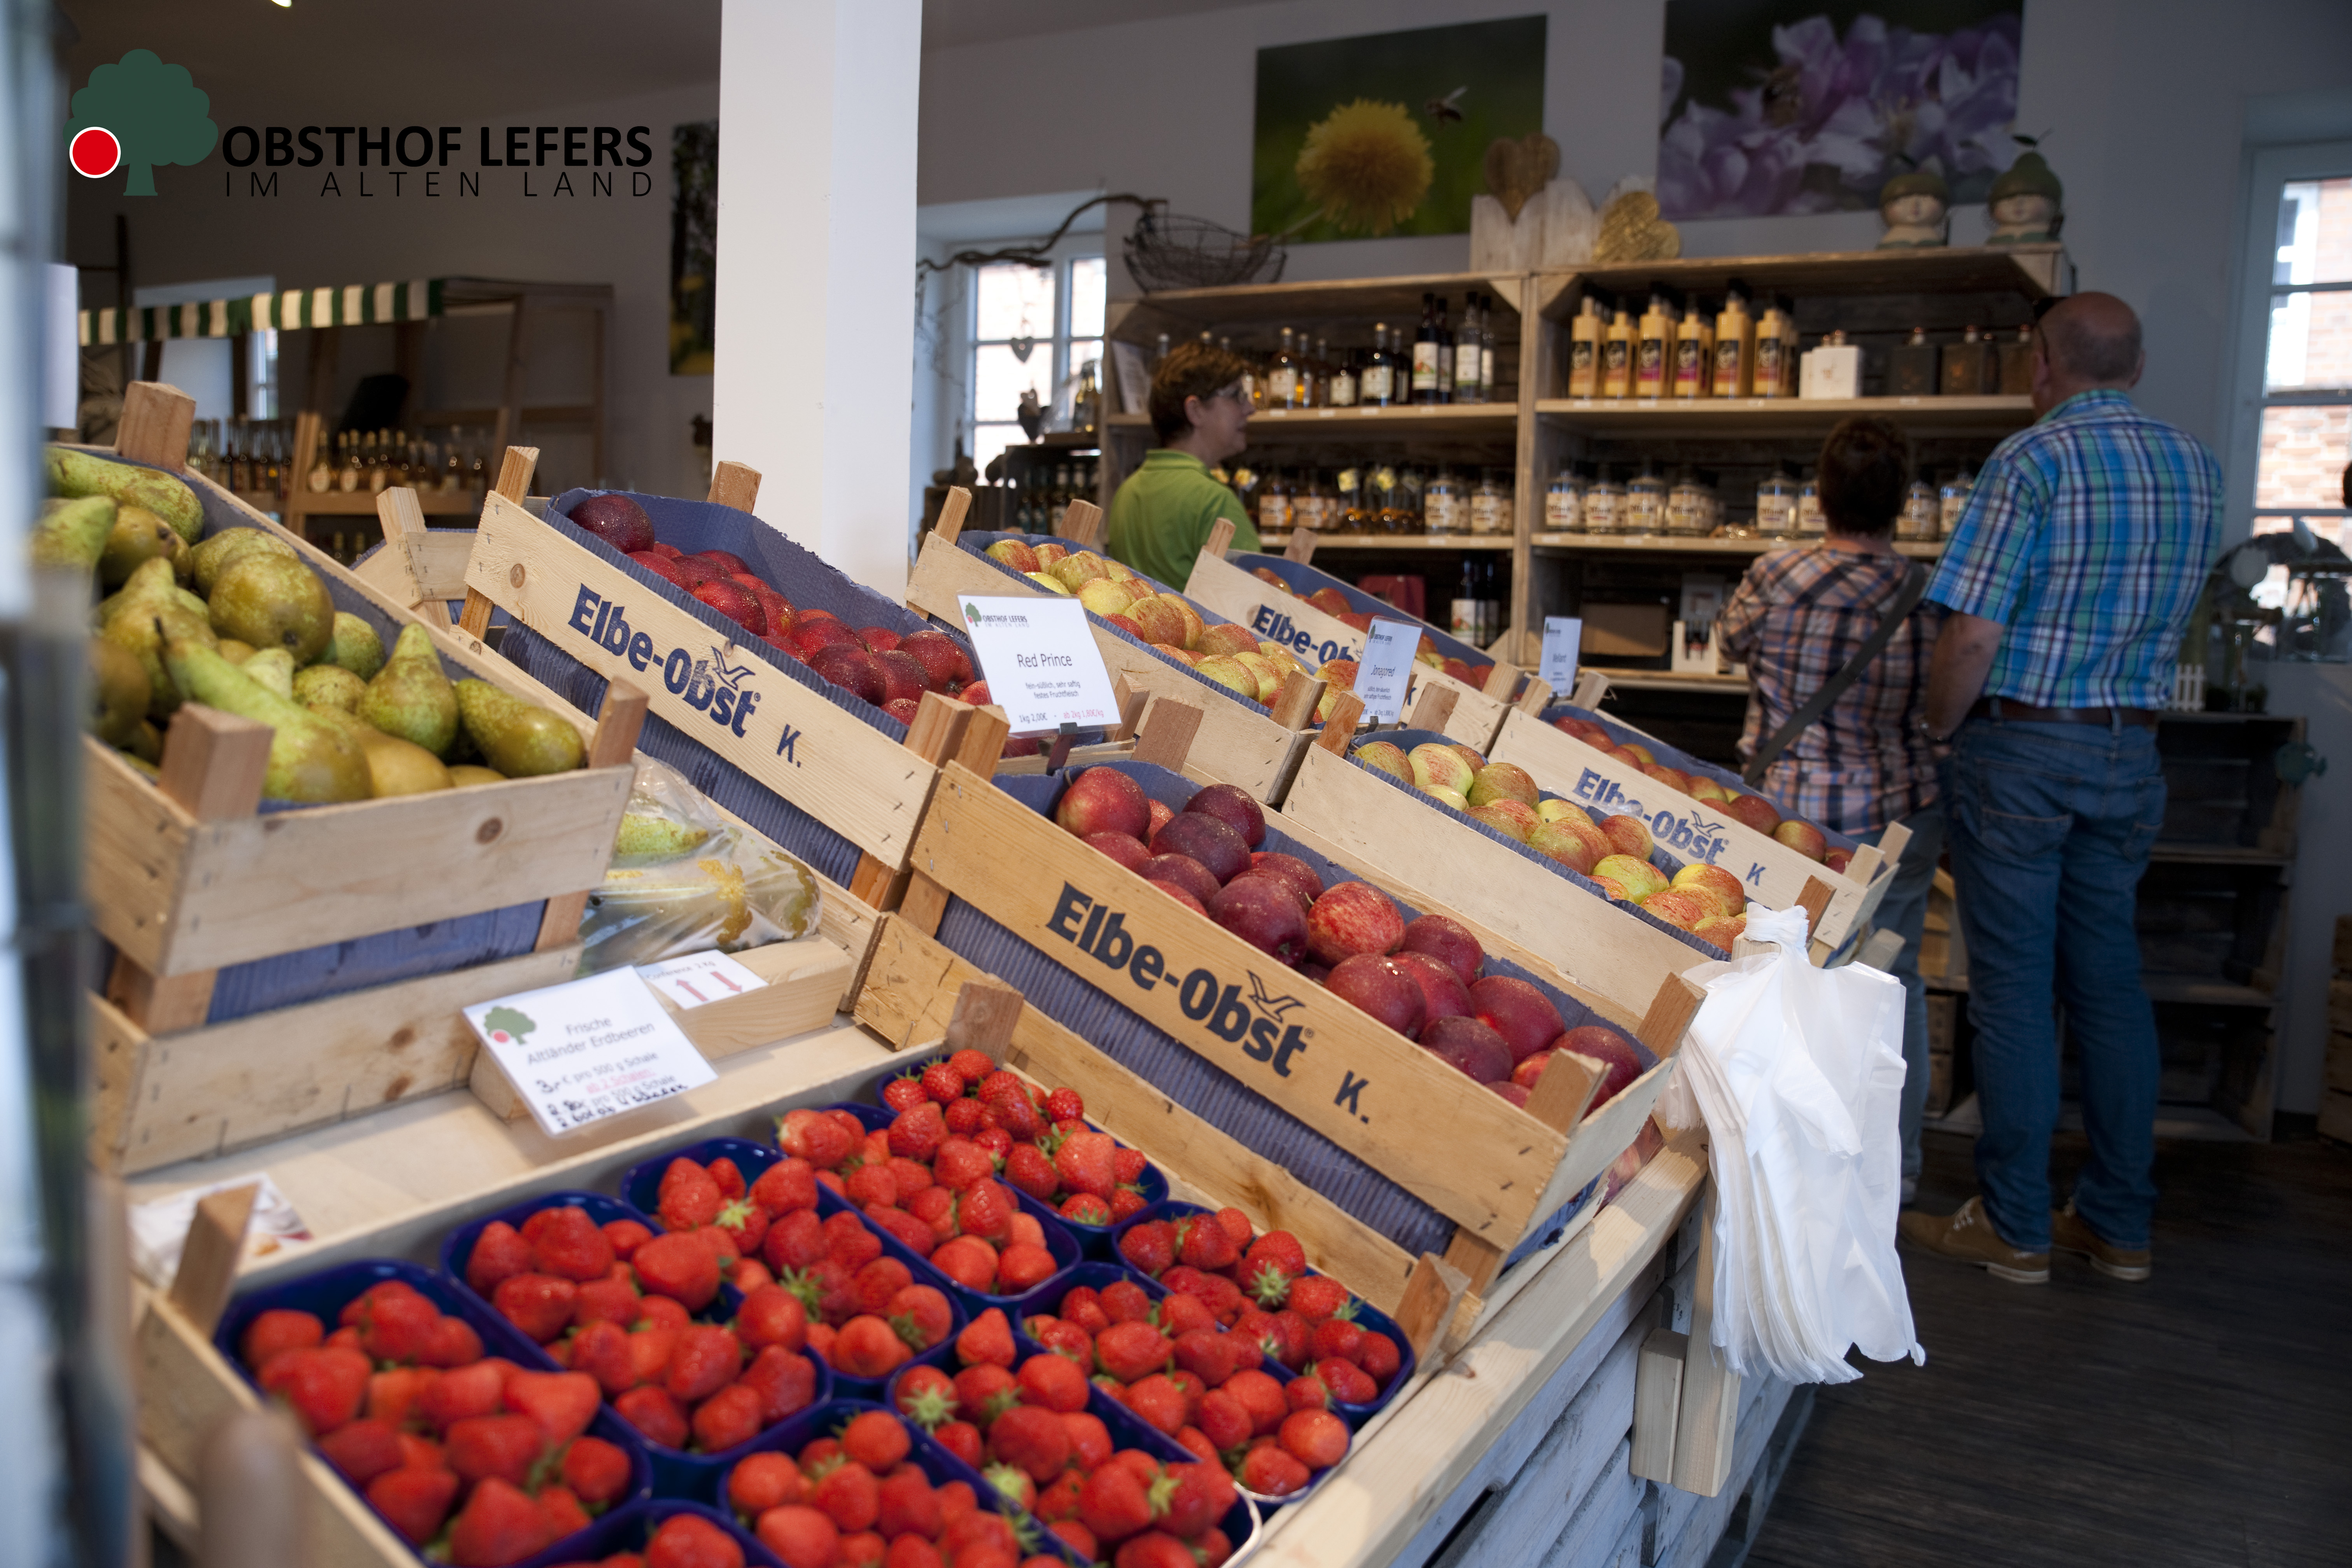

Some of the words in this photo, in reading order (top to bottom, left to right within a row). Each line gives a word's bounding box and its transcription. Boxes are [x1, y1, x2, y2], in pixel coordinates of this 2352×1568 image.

[1017, 654, 1038, 668] Red
[1041, 653, 1072, 667] Prince
[1370, 665, 1396, 679] Jonagored
[1020, 715, 1030, 723] 1kg
[1031, 712, 1048, 723] 2,00€
[1071, 710, 1081, 719] 2kg
[1082, 709, 1104, 719] 1,80€/kg
[776, 724, 802, 768] K.
[1746, 862, 1766, 886] K
[647, 966, 693, 980] Conference
[565, 1018, 612, 1036] Frische
[528, 1039, 586, 1065] Altländer
[592, 1022, 655, 1048] Erdbeeren
[573, 1071, 592, 1083] pro
[624, 1052, 659, 1067] Schale
[1334, 1070, 1370, 1124] K.
